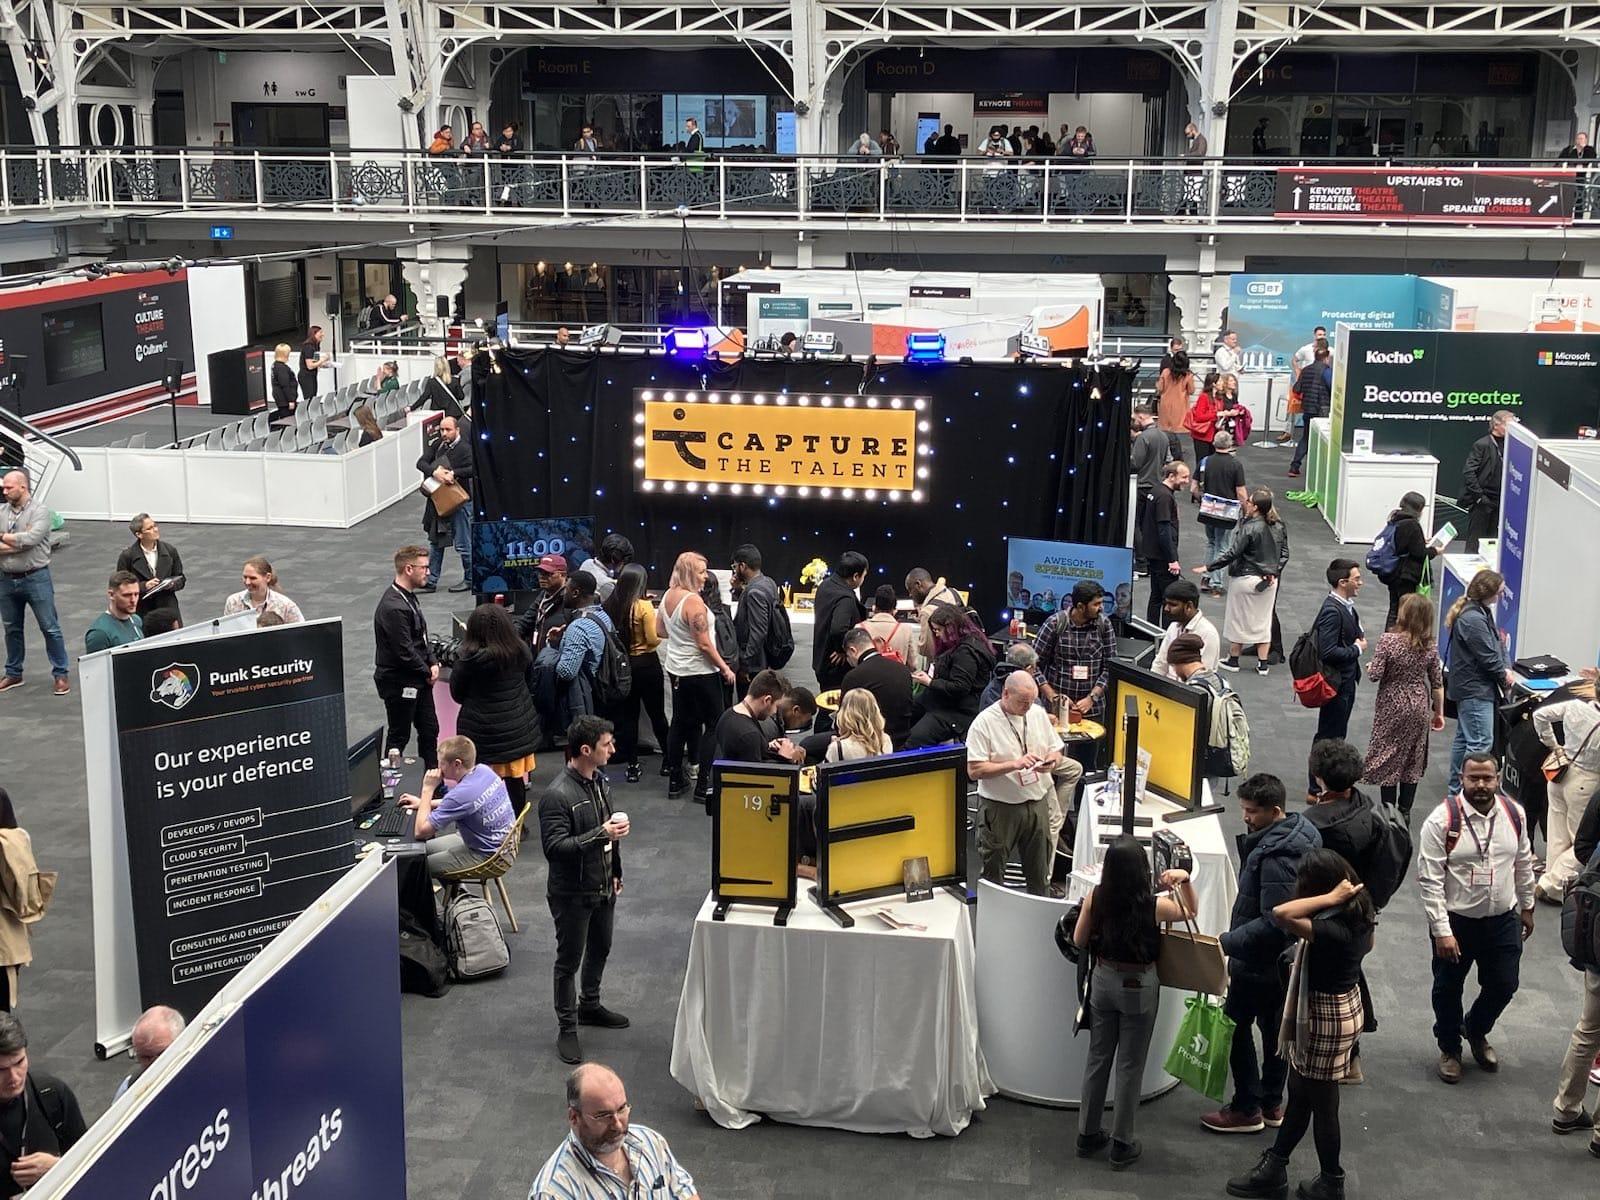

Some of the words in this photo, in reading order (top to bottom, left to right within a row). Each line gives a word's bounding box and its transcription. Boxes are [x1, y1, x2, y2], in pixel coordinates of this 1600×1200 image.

[978, 100, 1011, 108] KEYNOTE
[1386, 176, 1442, 186] UPSTAIRS
[1444, 176, 1464, 187] TO:
[1310, 187, 1352, 195] KEYNOTE
[1354, 187, 1394, 195] THEATRE
[1309, 195, 1356, 203] STRATEGY
[1308, 203, 1361, 211] RESILIENCE
[1442, 205, 1486, 213] SPEAKER
[1486, 206, 1531, 214] LOUNGES
[135, 309, 164, 324] CULTURE
[1322, 310, 1366, 320] Protecting
[1367, 311, 1394, 320] digital
[1365, 350, 1414, 364] Kocho
[1554, 352, 1590, 360] Microsoft
[1363, 385, 1444, 404] Become
[1446, 390, 1523, 408] greater.
[717, 432, 907, 456] CAPTURE
[718, 458, 771, 473] THE
[792, 460, 907, 478] TALENT
[506, 539, 565, 560] 11:00
[504, 558, 540, 568] BATTLE
[1044, 556, 1095, 568] AWESOME
[210, 668, 248, 686] Punk
[251, 658, 313, 679] Security
[154, 751, 193, 772] Our
[198, 730, 311, 763] experience
[156, 781, 175, 799] is
[178, 772, 227, 798] your
[232, 756, 314, 784] defence
[744, 795, 762, 811] 19
[167, 824, 215, 840] DEVSECOPS
[224, 814, 256, 828] DEVOPS
[169, 850, 197, 863] CLOUD
[198, 842, 238, 857] SECURITY
[171, 867, 228, 886] PENETRATION
[229, 859, 263, 872] TESTING
[173, 894, 212, 909] INCIDENT
[213, 884, 256, 900] RESPONSE
[176, 936, 227, 953] CONSULTING
[229, 931, 246, 941] AND
[179, 964, 203, 976] TEAM
